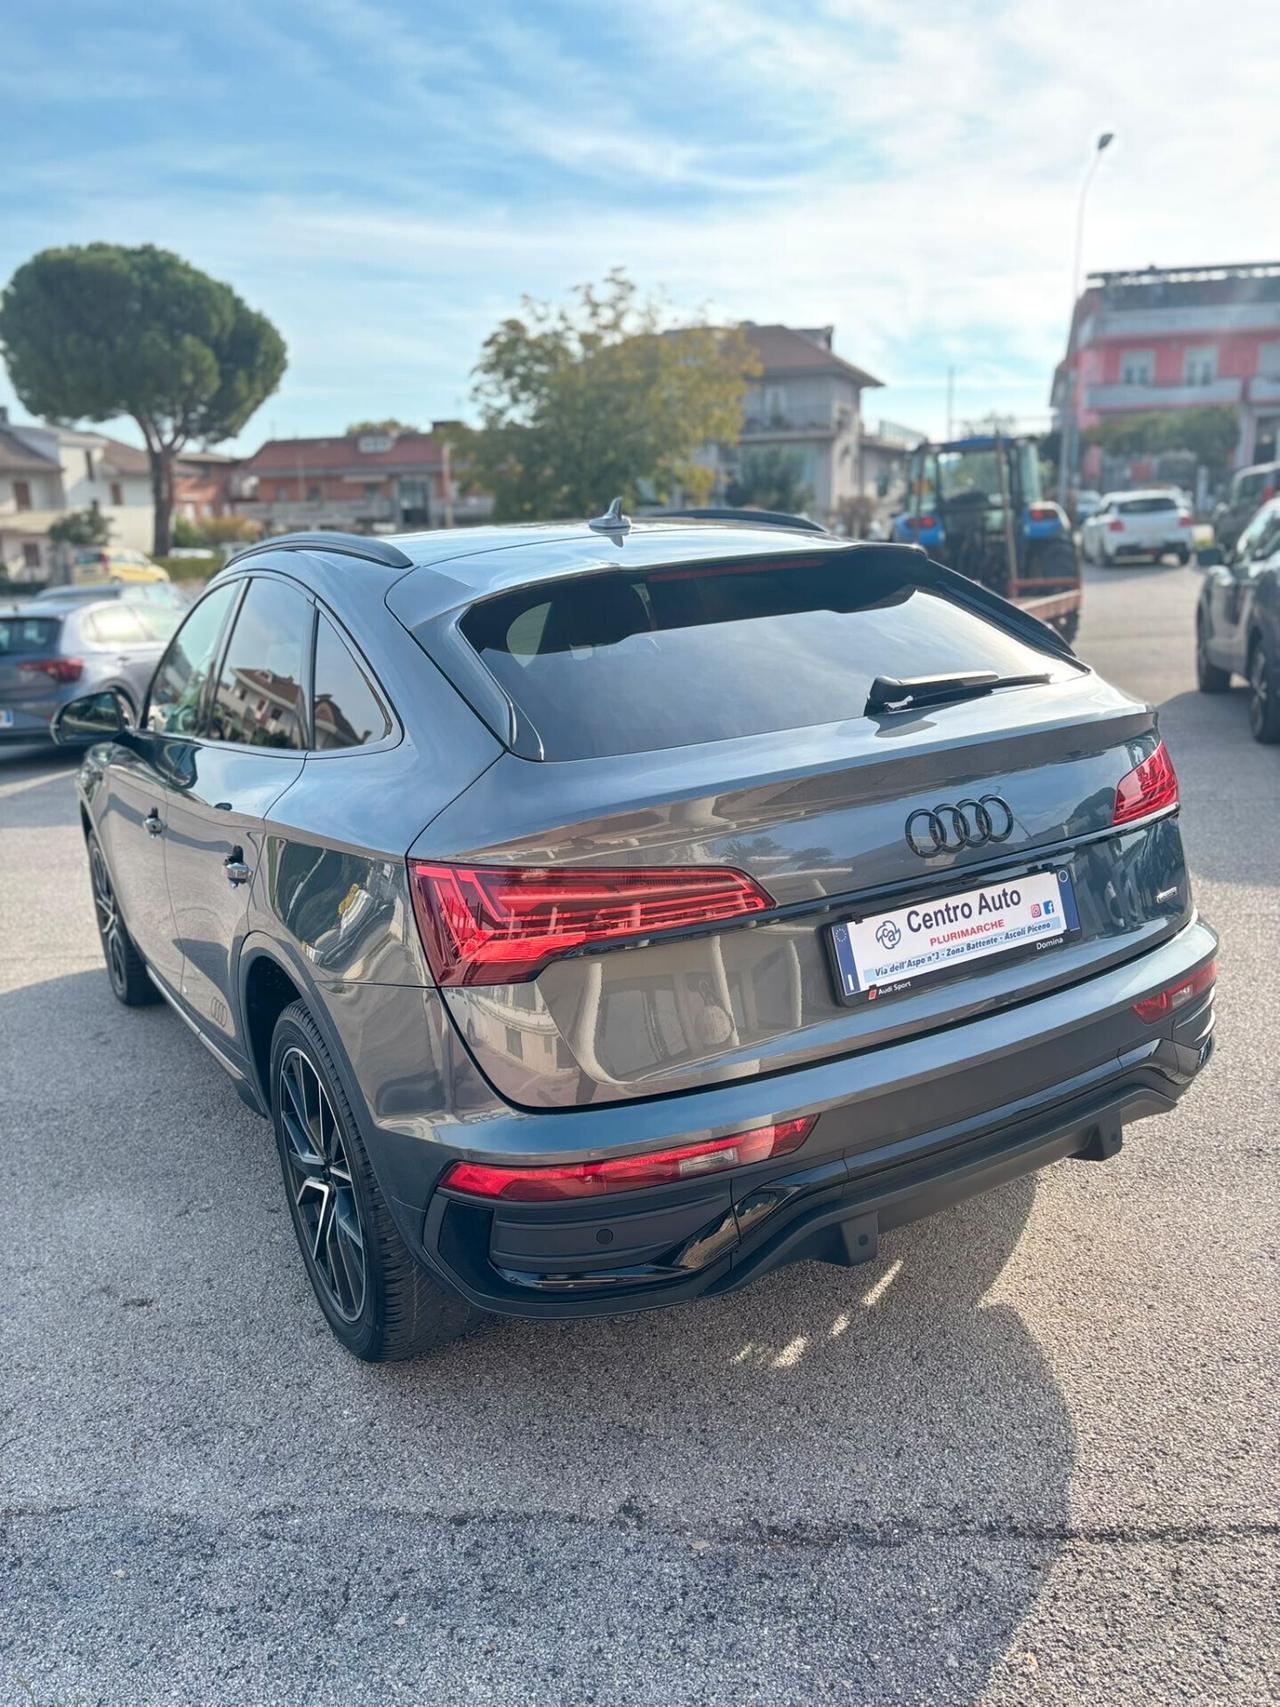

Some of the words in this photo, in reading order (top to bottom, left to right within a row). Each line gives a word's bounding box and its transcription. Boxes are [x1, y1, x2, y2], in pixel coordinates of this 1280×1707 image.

[907, 902, 972, 933] Centro
[978, 888, 1021, 915] Auto
[930, 919, 1005, 946] PLURIMARCHE
[1036, 937, 1063, 950] Domina
[875, 965, 888, 977] Via
[889, 956, 926, 974] dell'Aspo
[947, 946, 965, 957] Zona
[966, 937, 998, 953] Battente
[1004, 928, 1026, 941] Ascoli
[1027, 921, 1051, 935] Piceno
[878, 985, 892, 996] Audi
[894, 981, 911, 993] Sport
